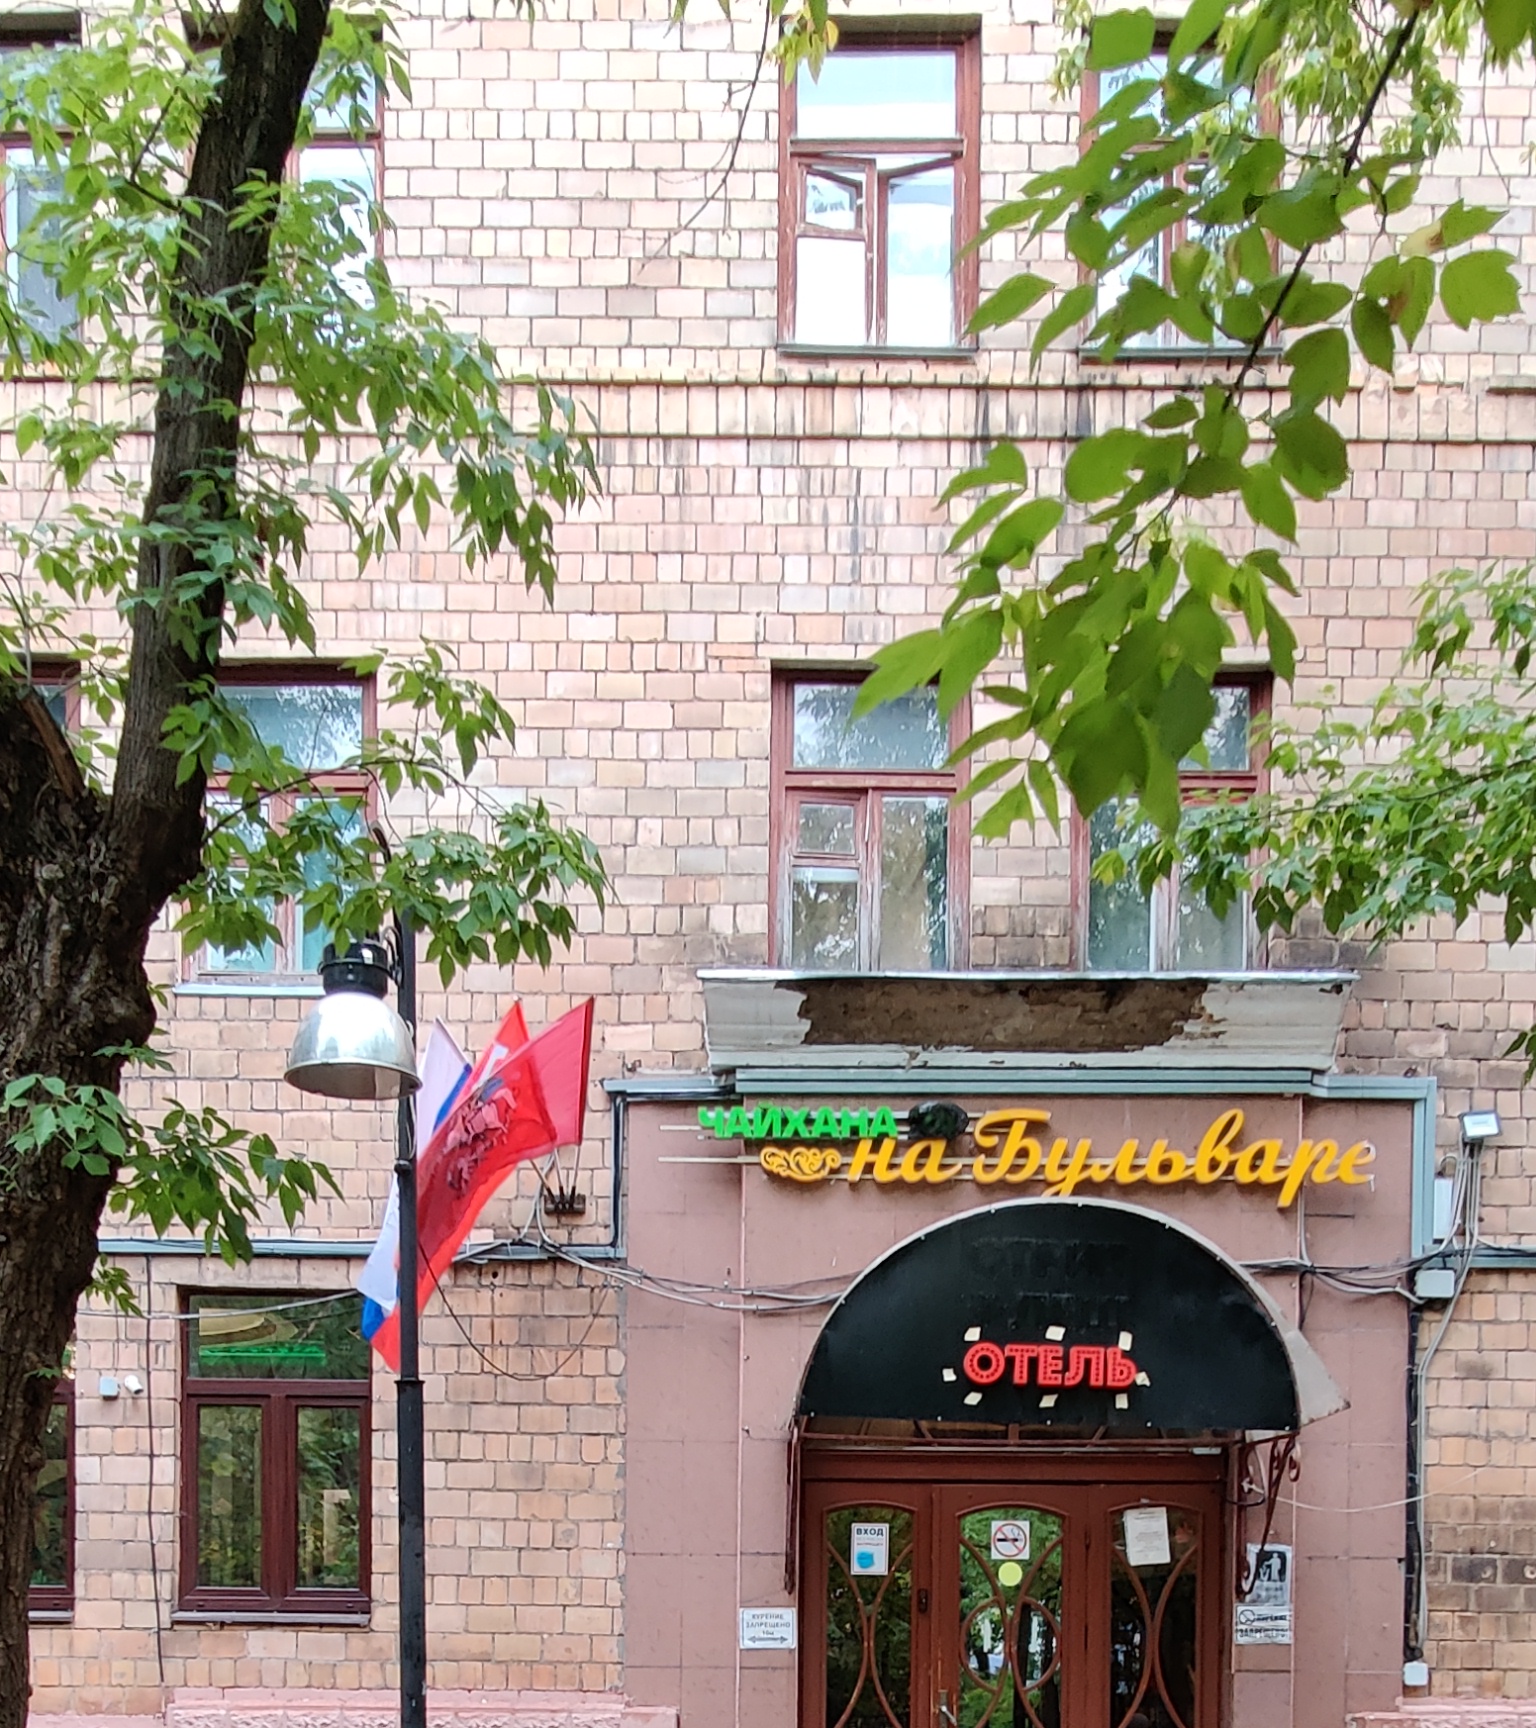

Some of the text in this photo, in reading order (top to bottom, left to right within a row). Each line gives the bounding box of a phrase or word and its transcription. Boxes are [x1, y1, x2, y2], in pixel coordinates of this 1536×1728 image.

[697, 1102, 899, 1138] ЧАЙХАНА
[847, 1108, 1376, 1208] на Бульваре
[963, 1341, 1137, 1388] ОТЕЛЬ
[856, 1527, 884, 1537] ВХОД
